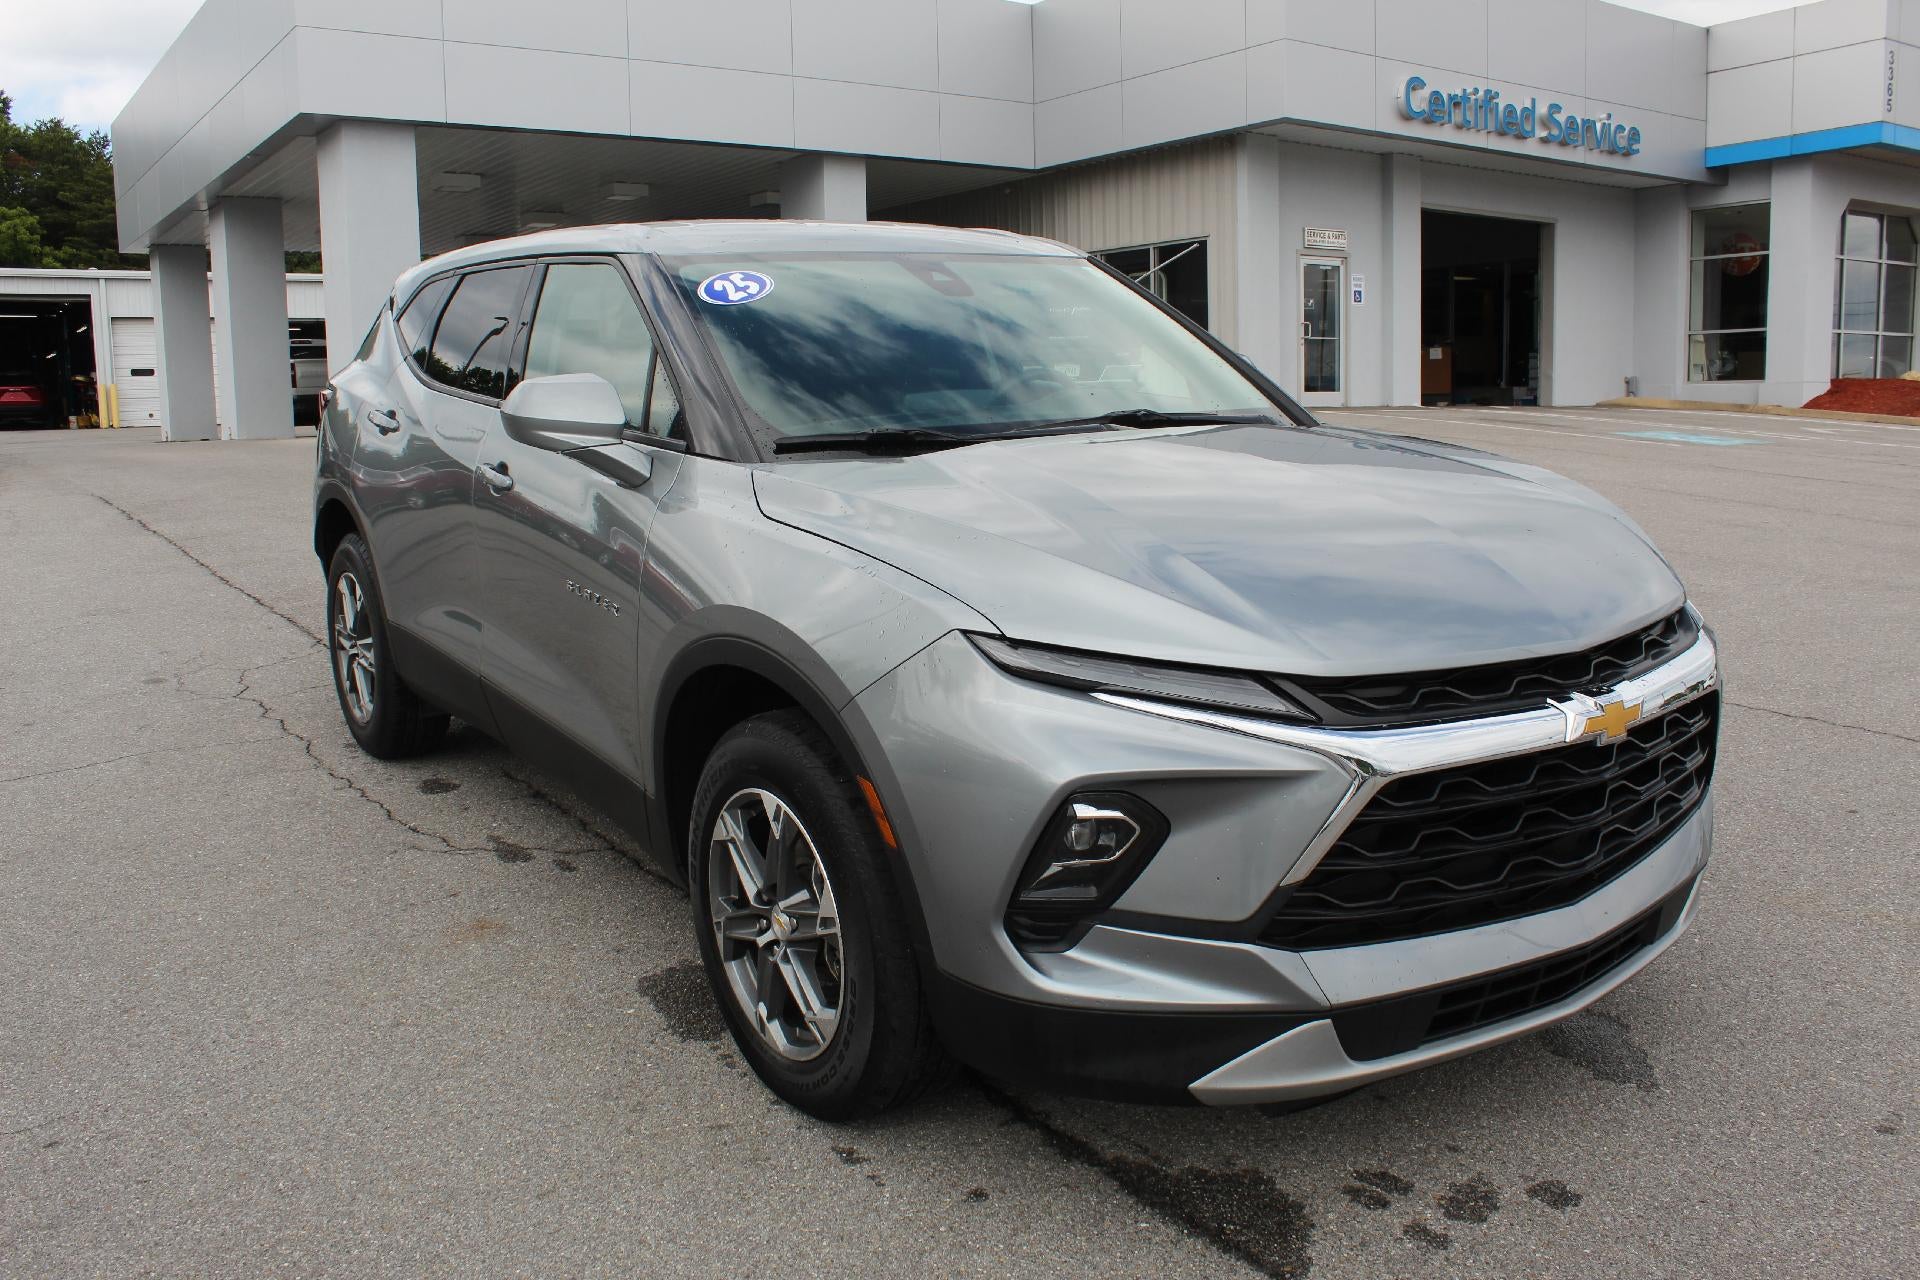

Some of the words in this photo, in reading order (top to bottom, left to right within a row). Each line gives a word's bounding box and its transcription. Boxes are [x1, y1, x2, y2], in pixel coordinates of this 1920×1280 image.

[1886, 49, 1895, 113] 3365
[1400, 75, 1537, 139] Certified
[1544, 102, 1642, 156] Service
[1306, 230, 1327, 239] SERVICE
[713, 272, 760, 301] 25
[566, 579, 620, 617] BLAZER
